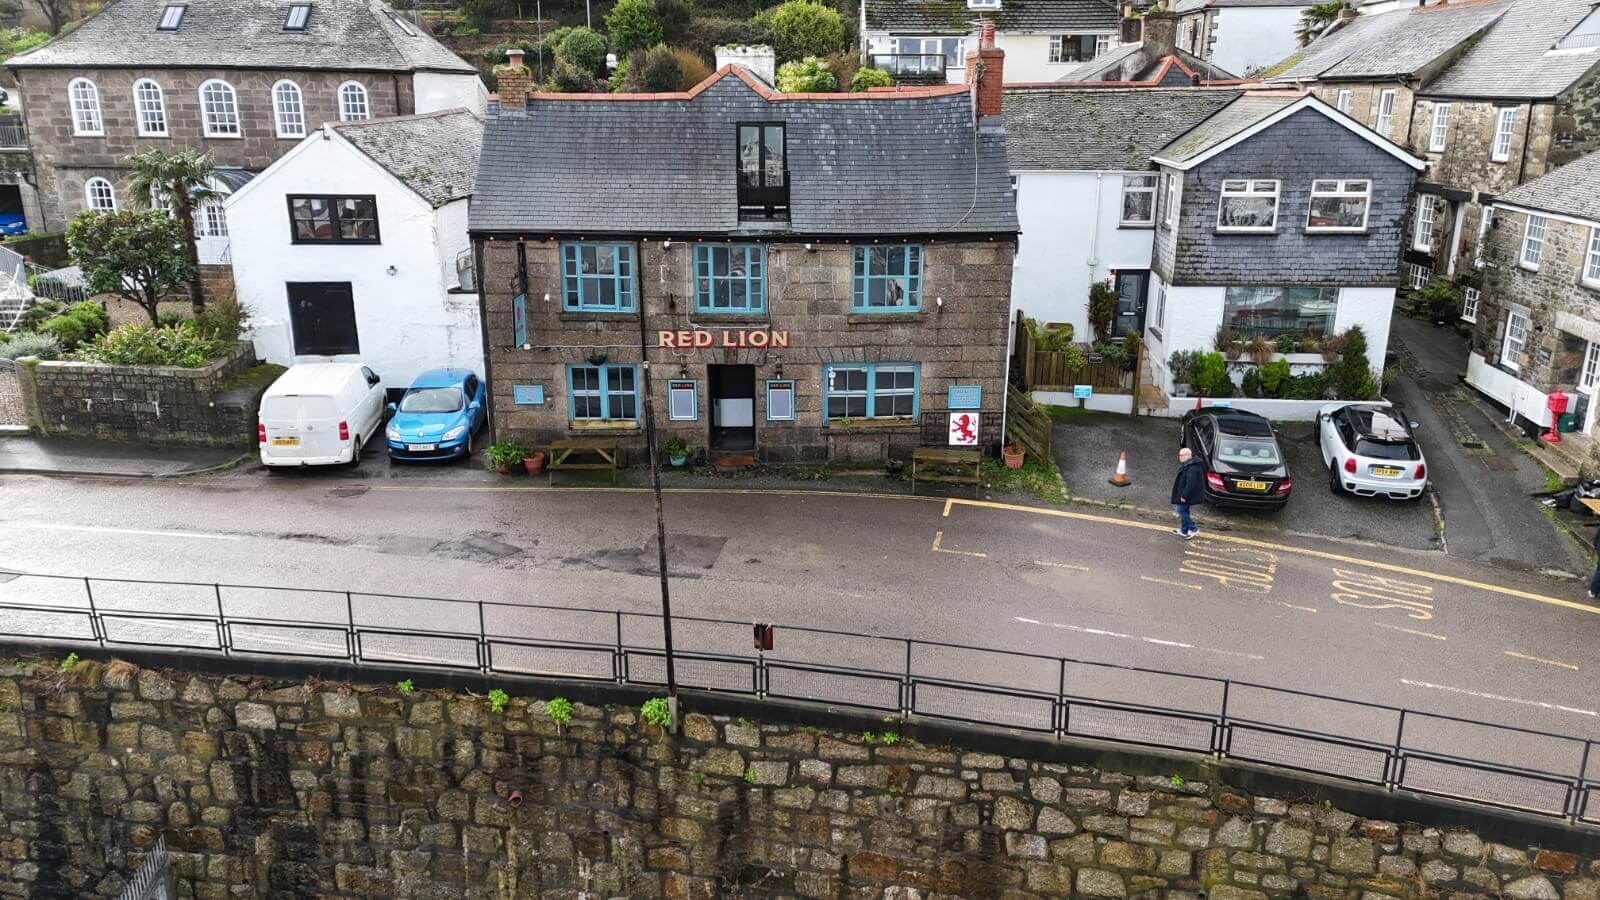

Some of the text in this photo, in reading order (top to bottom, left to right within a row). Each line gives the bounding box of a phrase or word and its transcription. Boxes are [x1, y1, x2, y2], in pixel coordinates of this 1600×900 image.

[658, 330, 790, 348] RED LION
[1179, 539, 1279, 594] STOP
[1331, 567, 1434, 620] BUS
